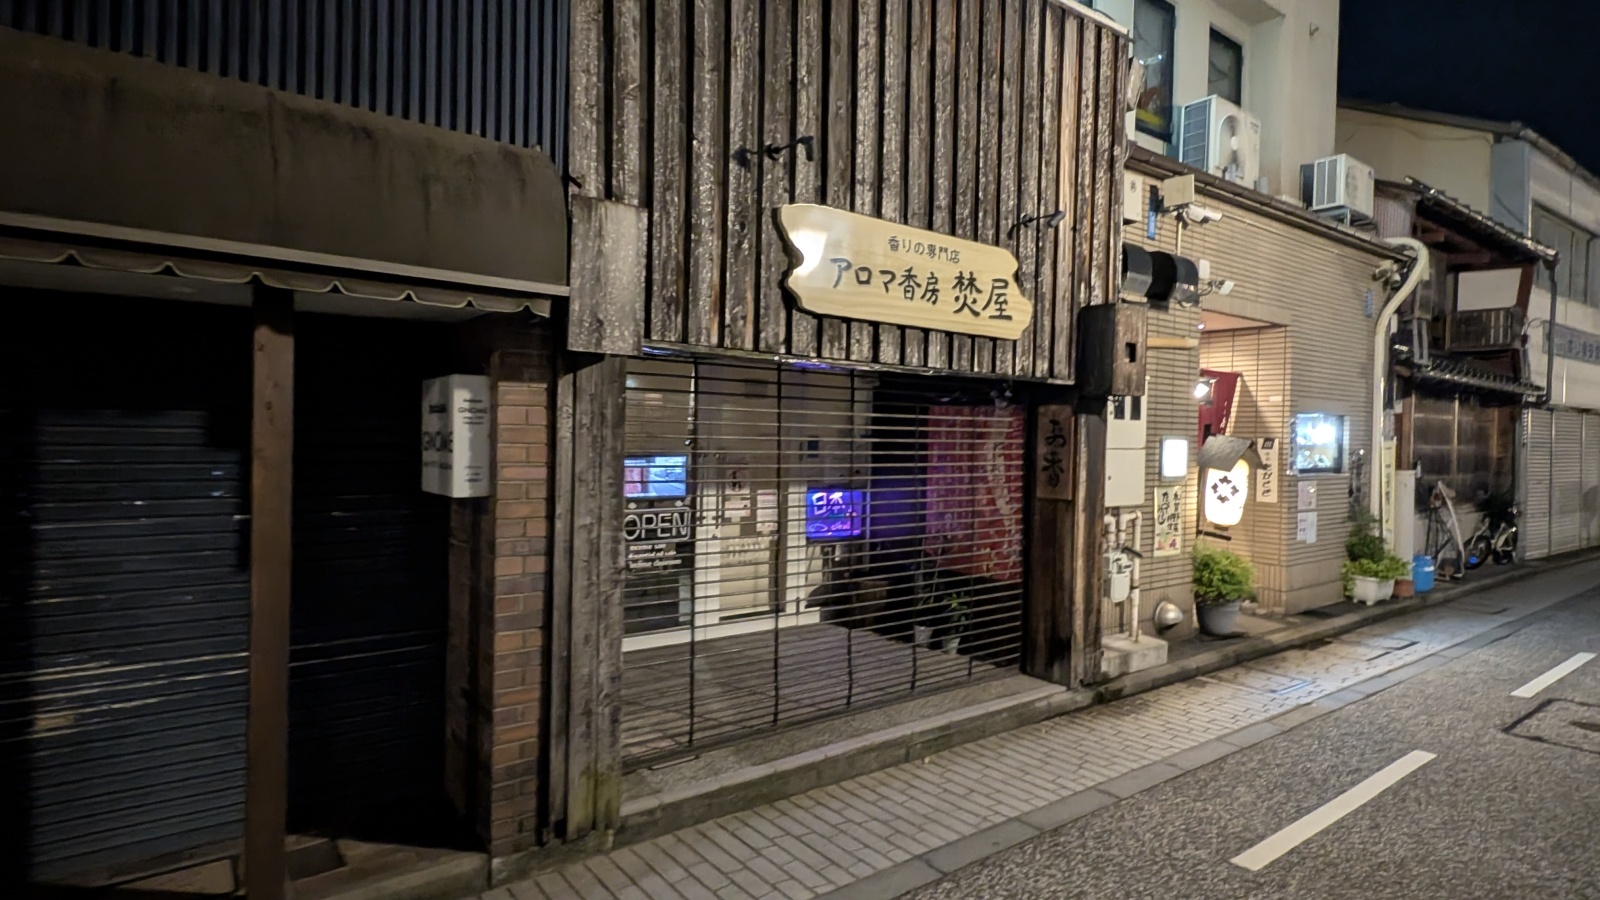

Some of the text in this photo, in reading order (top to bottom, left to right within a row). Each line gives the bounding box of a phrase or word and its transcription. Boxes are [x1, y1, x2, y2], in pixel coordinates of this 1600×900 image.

[888, 236, 960, 263] 香りの専門店
[624, 513, 688, 540] OPEN
